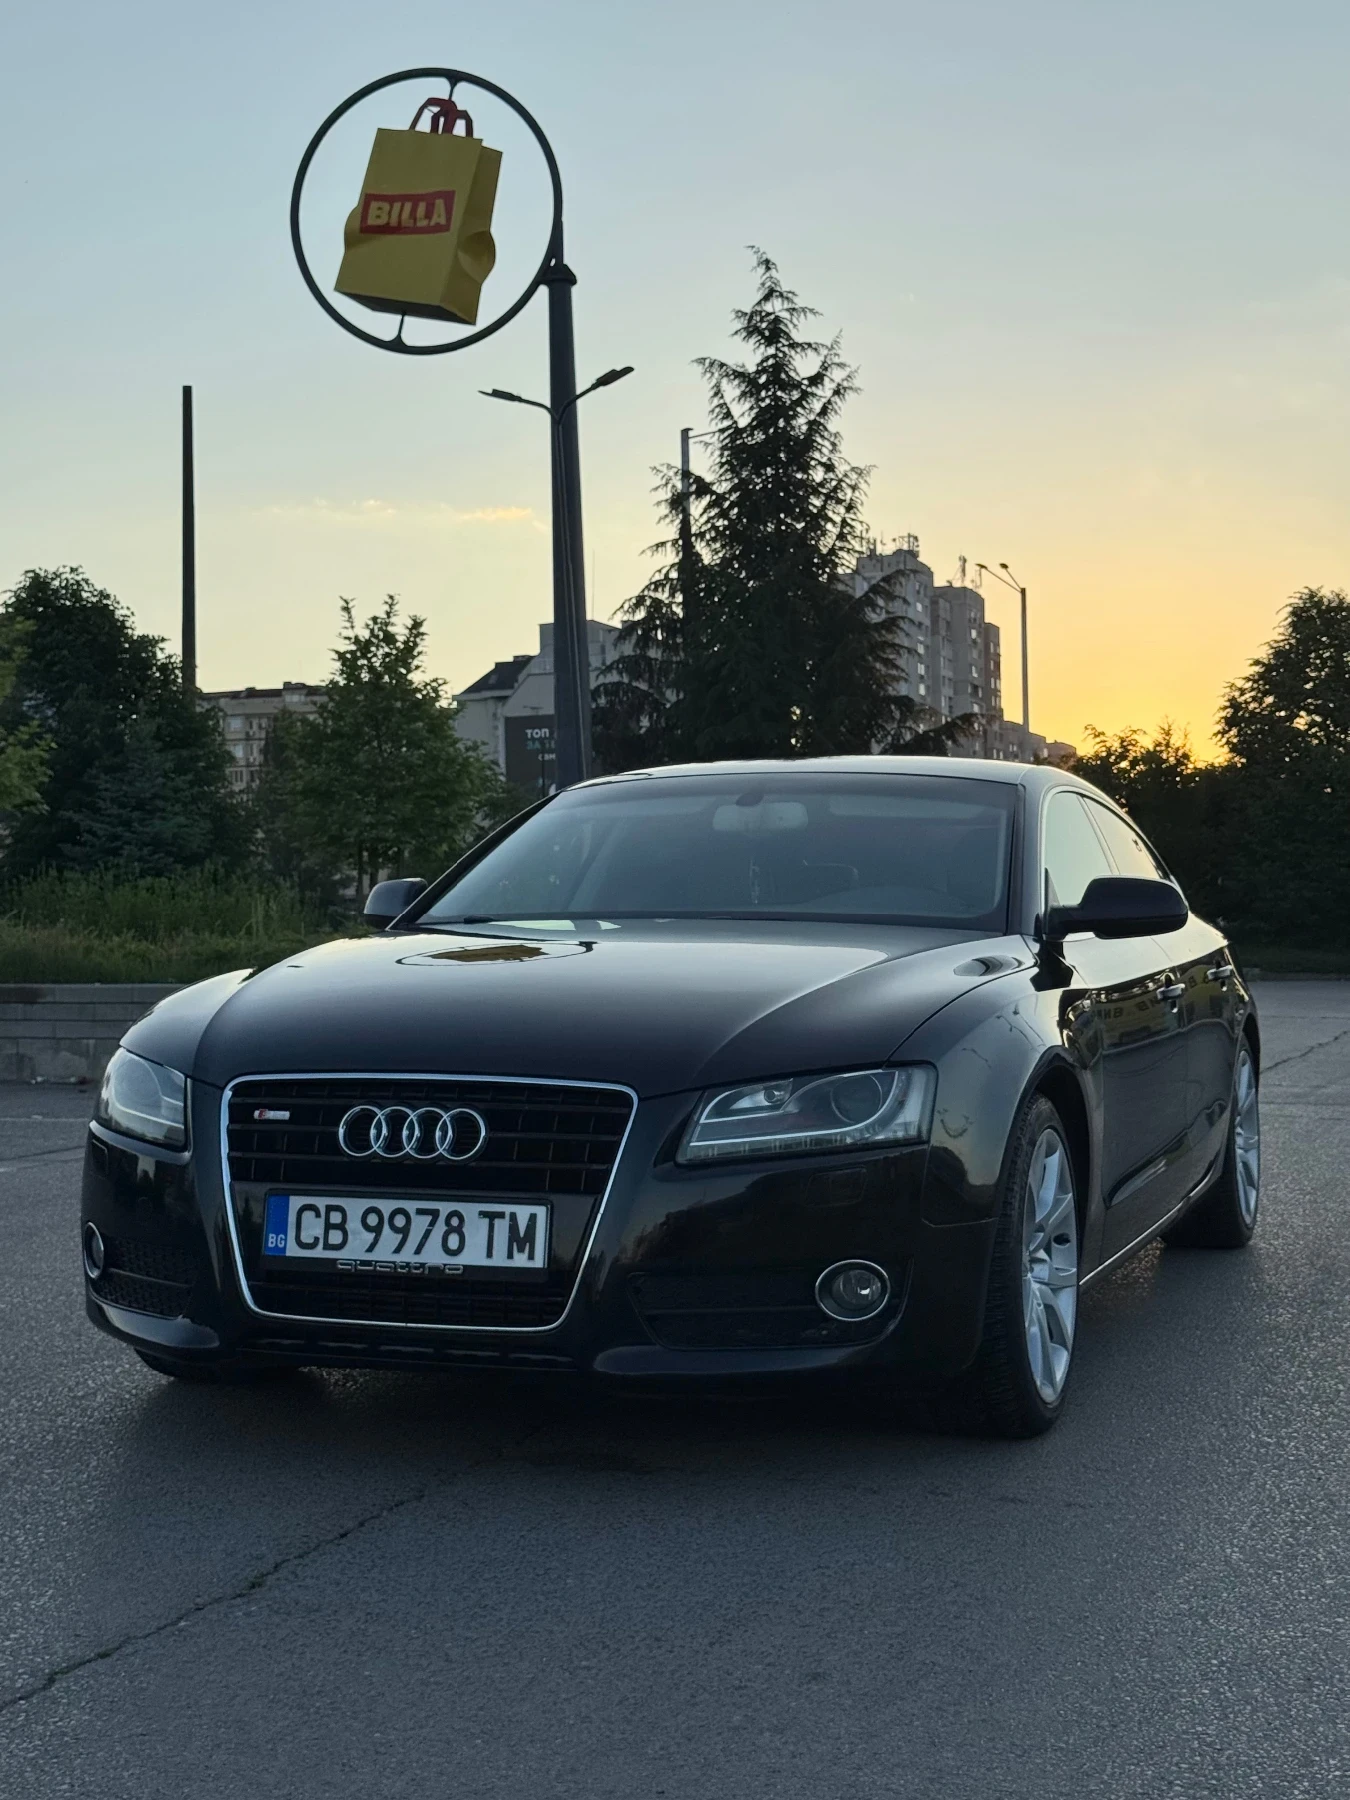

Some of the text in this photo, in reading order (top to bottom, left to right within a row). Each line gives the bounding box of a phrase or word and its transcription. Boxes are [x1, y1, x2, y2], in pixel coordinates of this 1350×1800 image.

[367, 198, 447, 227] BILLA
[267, 1233, 286, 1249] BG
[294, 1203, 538, 1261] CB 9978 TM
[336, 1259, 464, 1274] quattro
